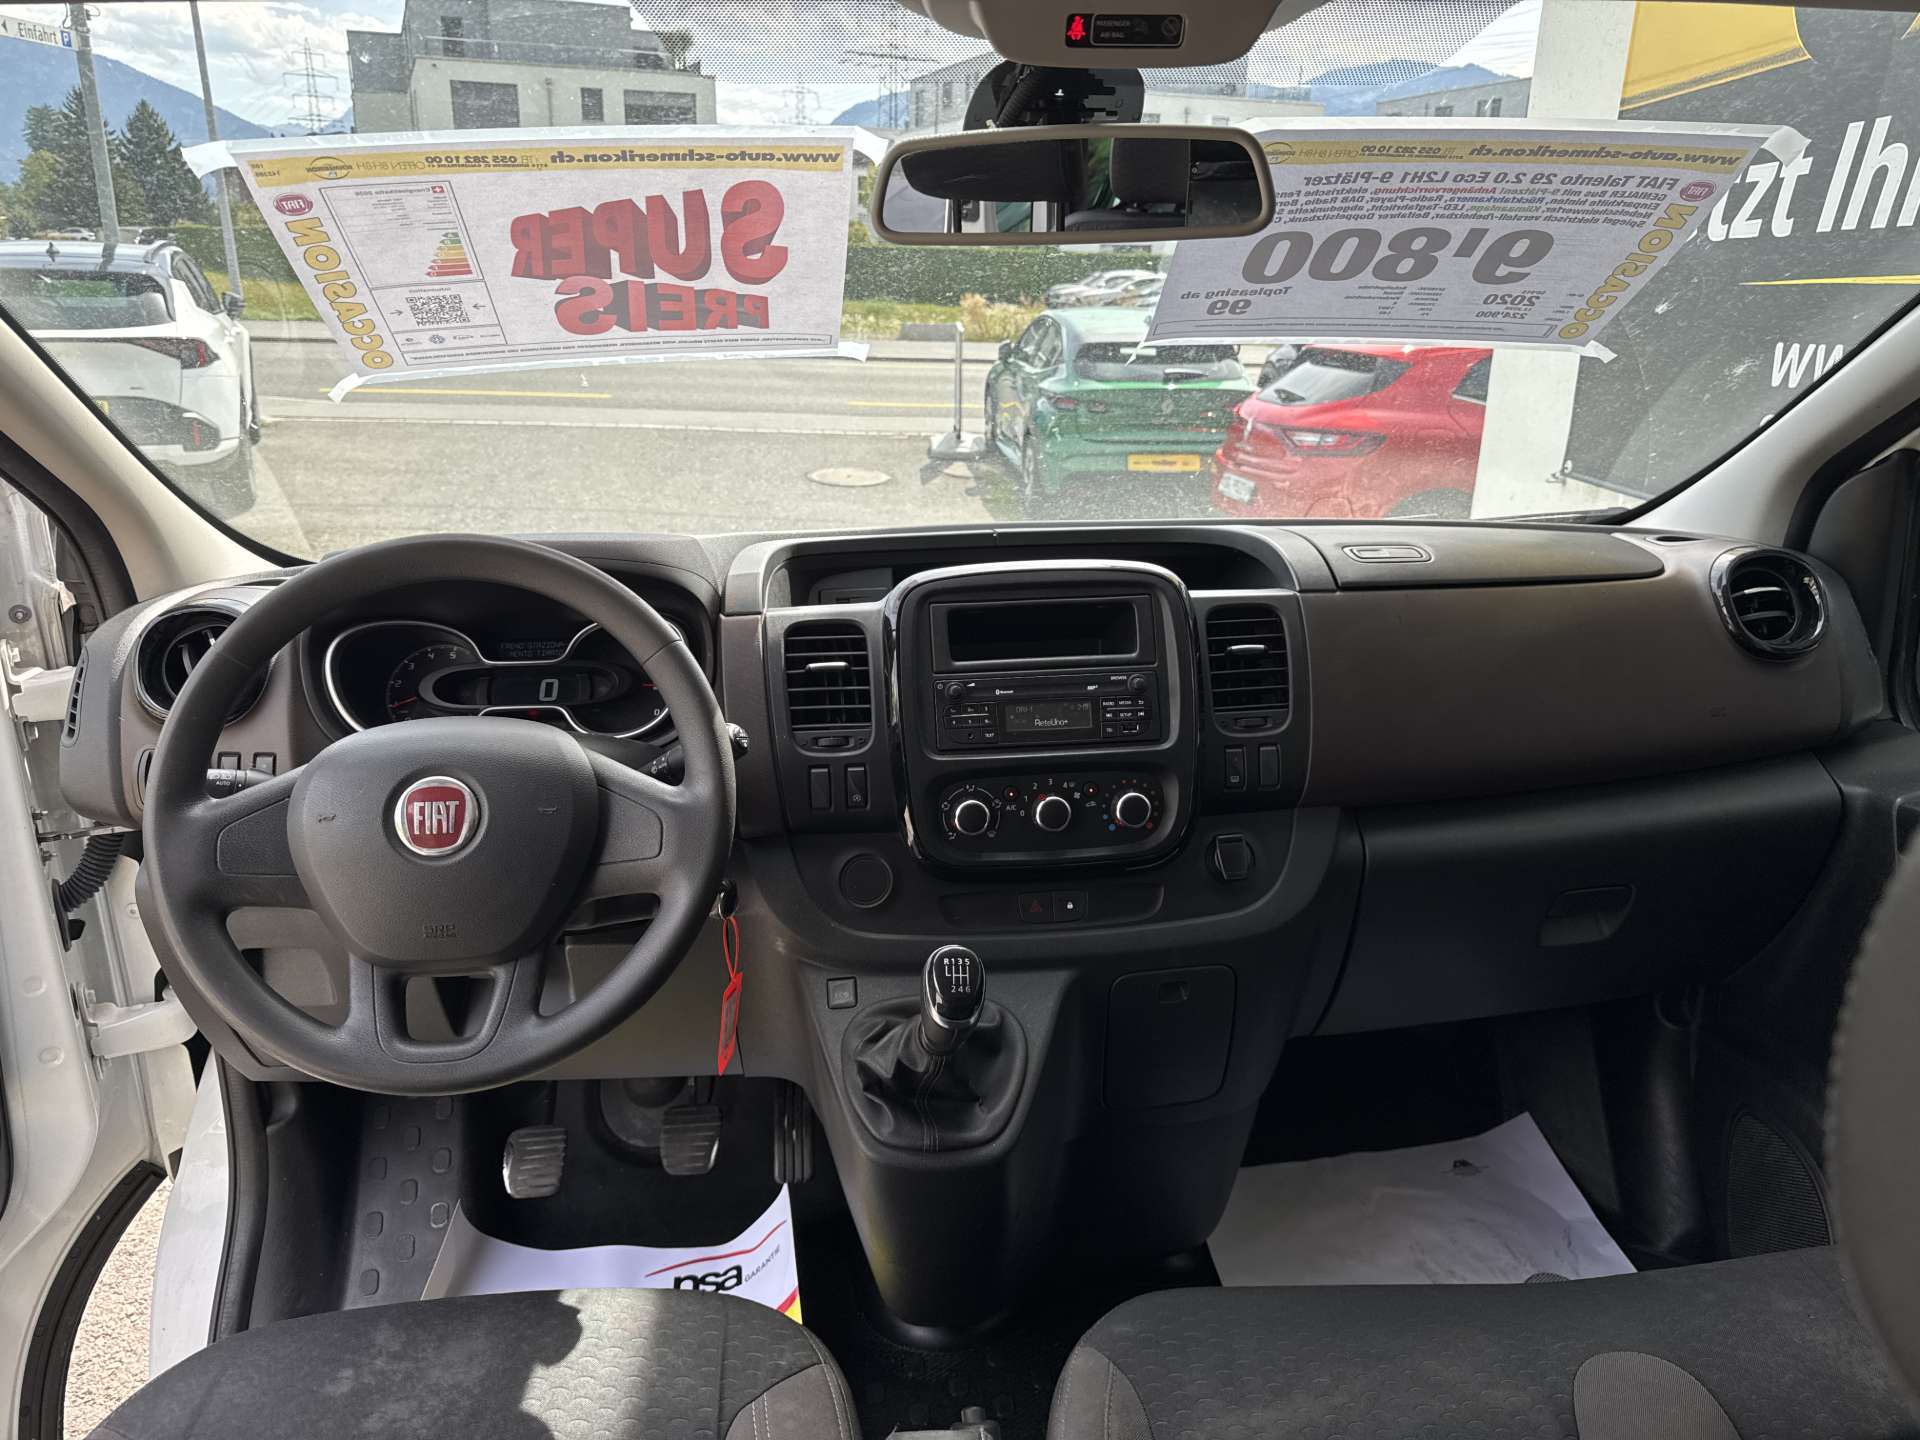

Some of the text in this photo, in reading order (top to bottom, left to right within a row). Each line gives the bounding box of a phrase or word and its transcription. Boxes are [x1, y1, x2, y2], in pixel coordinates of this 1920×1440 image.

[17, 22, 59, 45] Einfahrt
[539, 678, 559, 702] 0
[413, 800, 460, 835] FIAT
[673, 1263, 742, 1293] nsa
